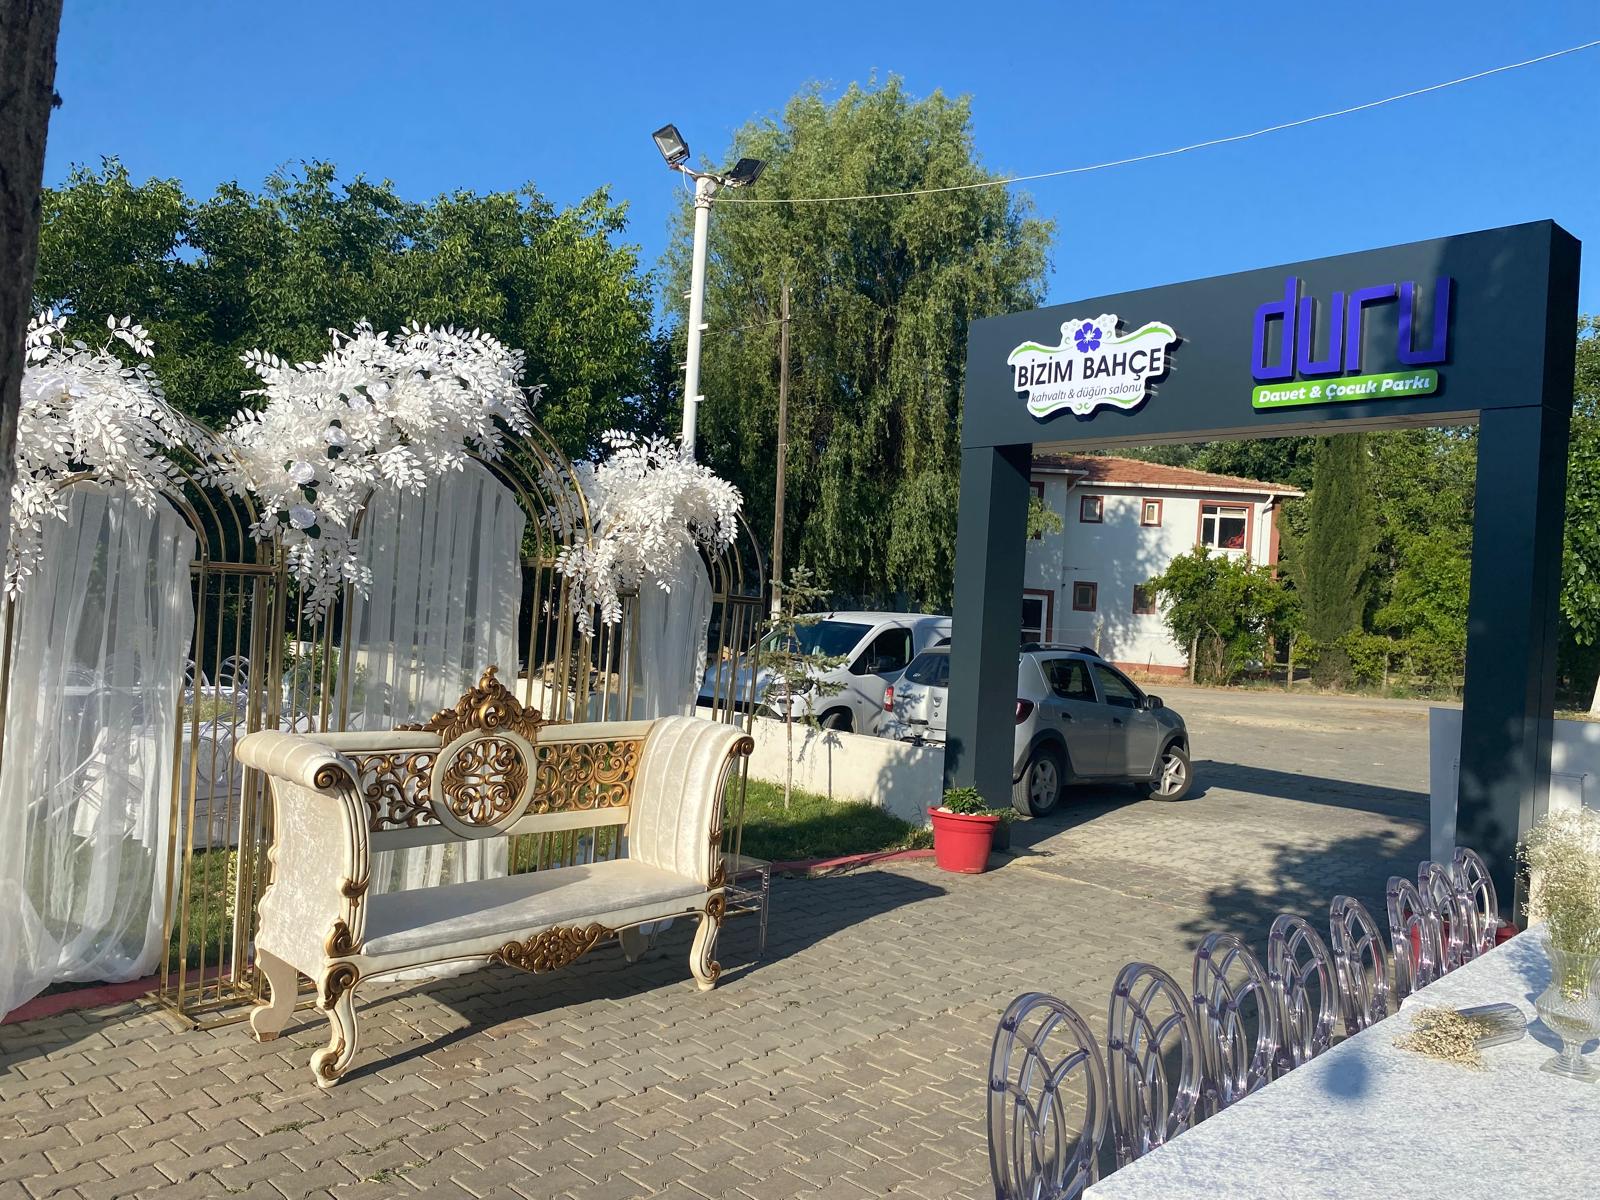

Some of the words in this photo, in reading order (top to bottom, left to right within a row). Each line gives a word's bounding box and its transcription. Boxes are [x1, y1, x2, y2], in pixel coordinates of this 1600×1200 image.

[1252, 276, 1450, 379] duru
[1017, 356, 1073, 387] BİZİM
[1083, 348, 1161, 380] BAHÇE
[1031, 391, 1066, 402] kahvaltı
[1067, 389, 1075, 398] &
[1076, 387, 1107, 401] düğün
[1108, 384, 1141, 396] salonu
[1259, 387, 1306, 402] Davet
[1309, 386, 1322, 398] &
[1325, 380, 1377, 400] Çocuk
[1381, 376, 1430, 392] Parkı
